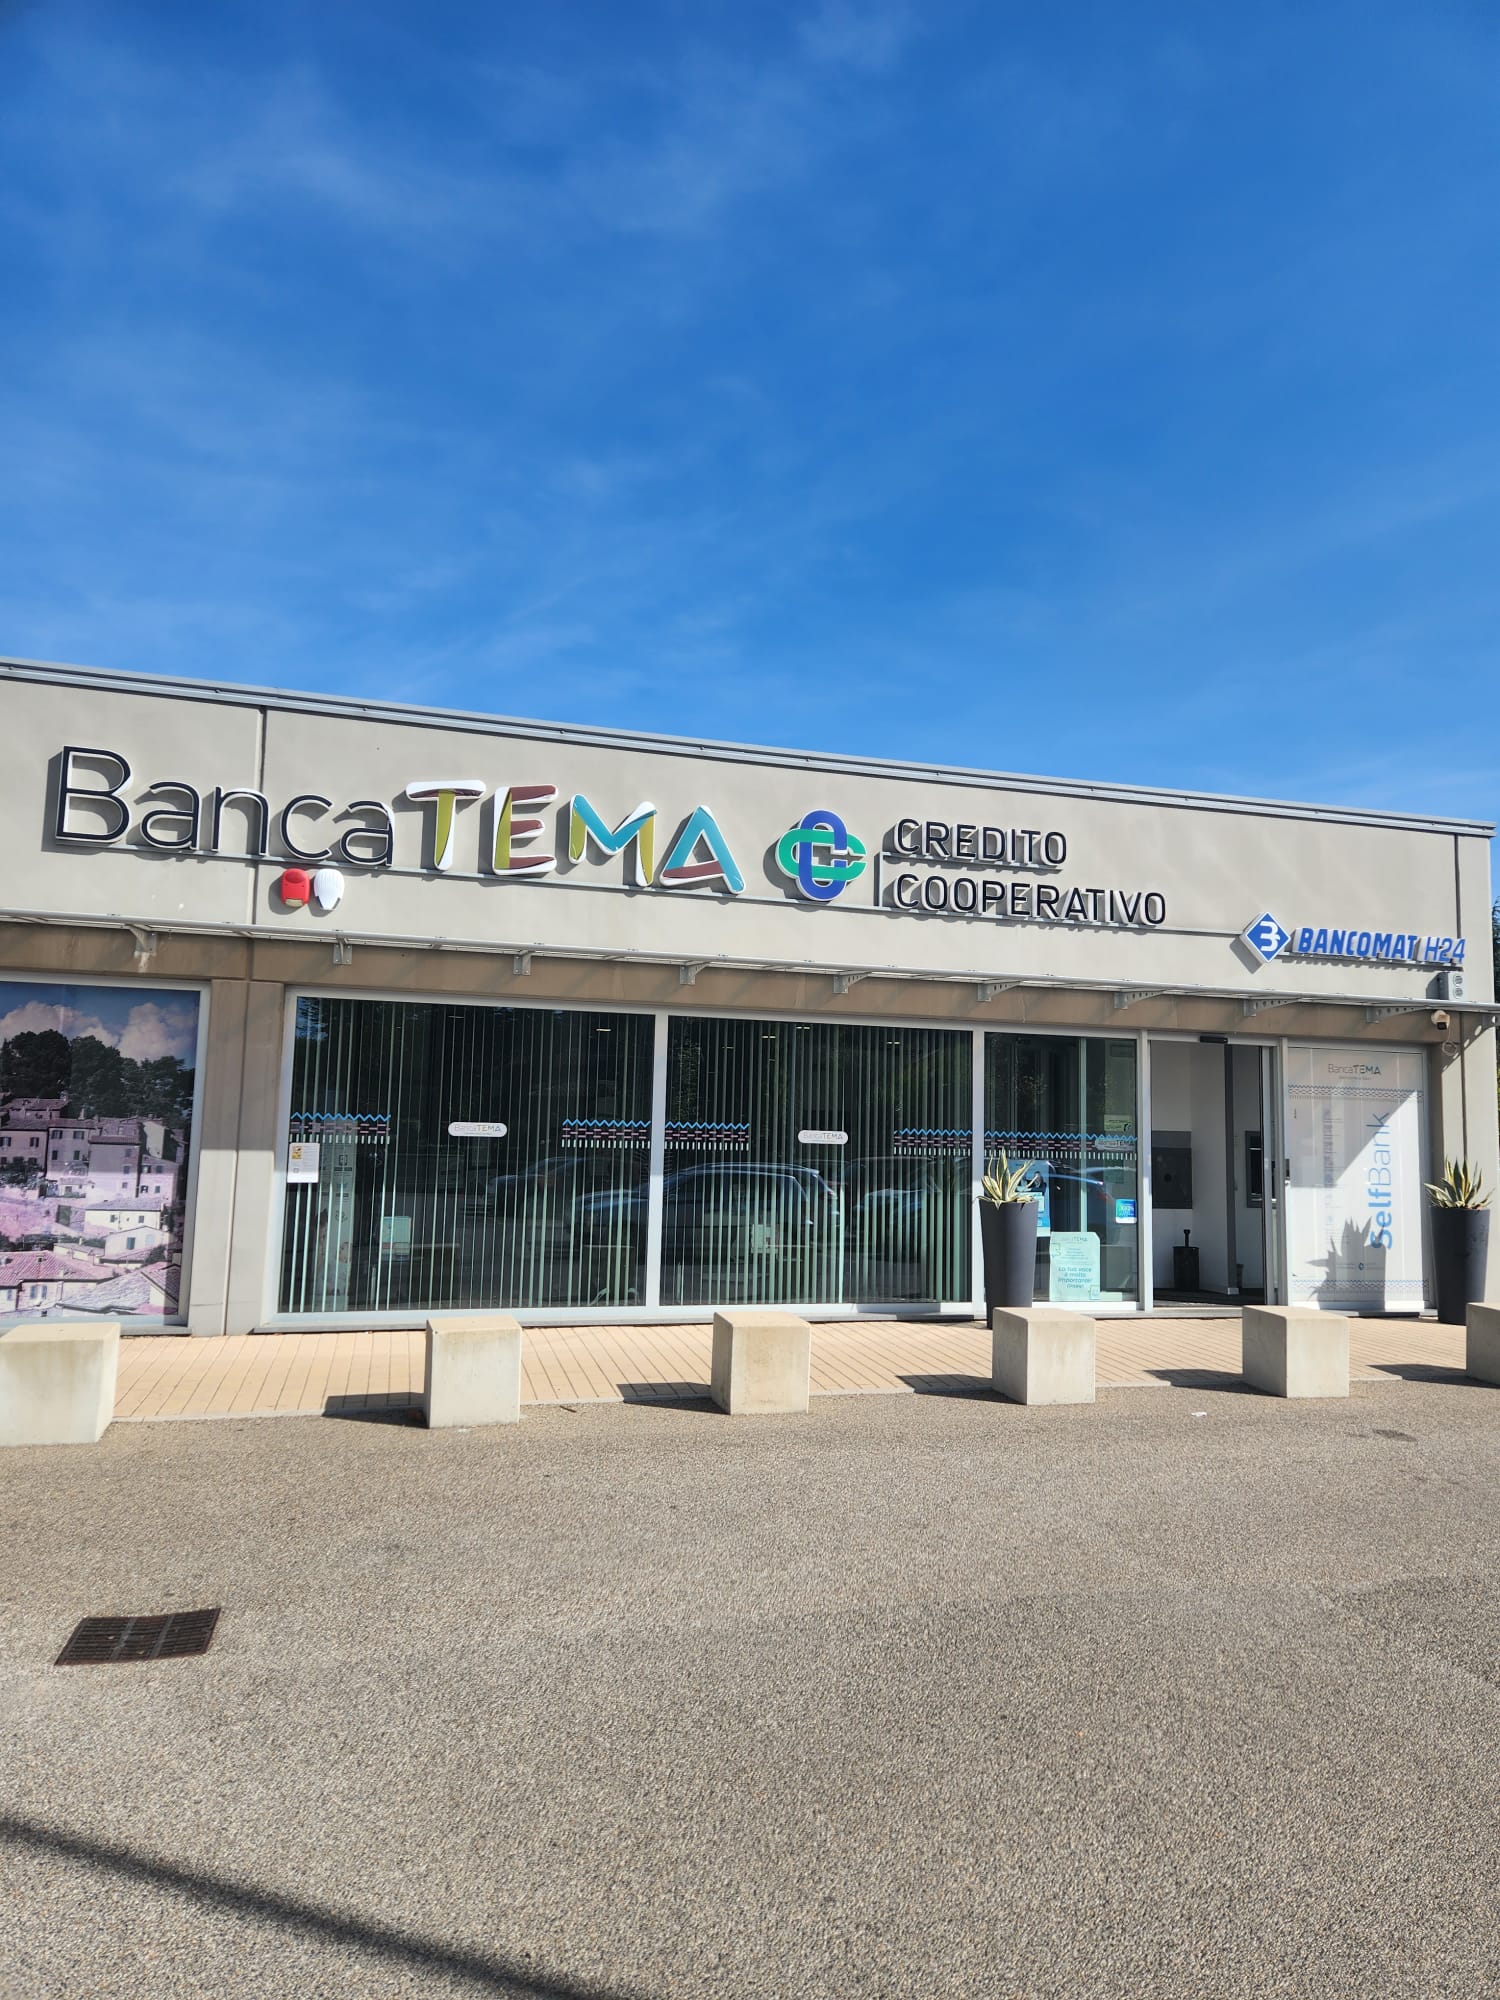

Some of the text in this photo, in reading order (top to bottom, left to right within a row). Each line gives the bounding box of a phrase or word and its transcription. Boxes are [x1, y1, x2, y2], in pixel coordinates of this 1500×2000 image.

[55, 745, 746, 894] BancaTEMA
[895, 818, 1067, 866] CREDITO
[894, 873, 1167, 925] COOPERATIVO
[1297, 926, 1467, 964] BANCOMAT H24
[1327, 1063, 1382, 1075] BancaTEMA
[1366, 1112, 1393, 1250] SelfBank
